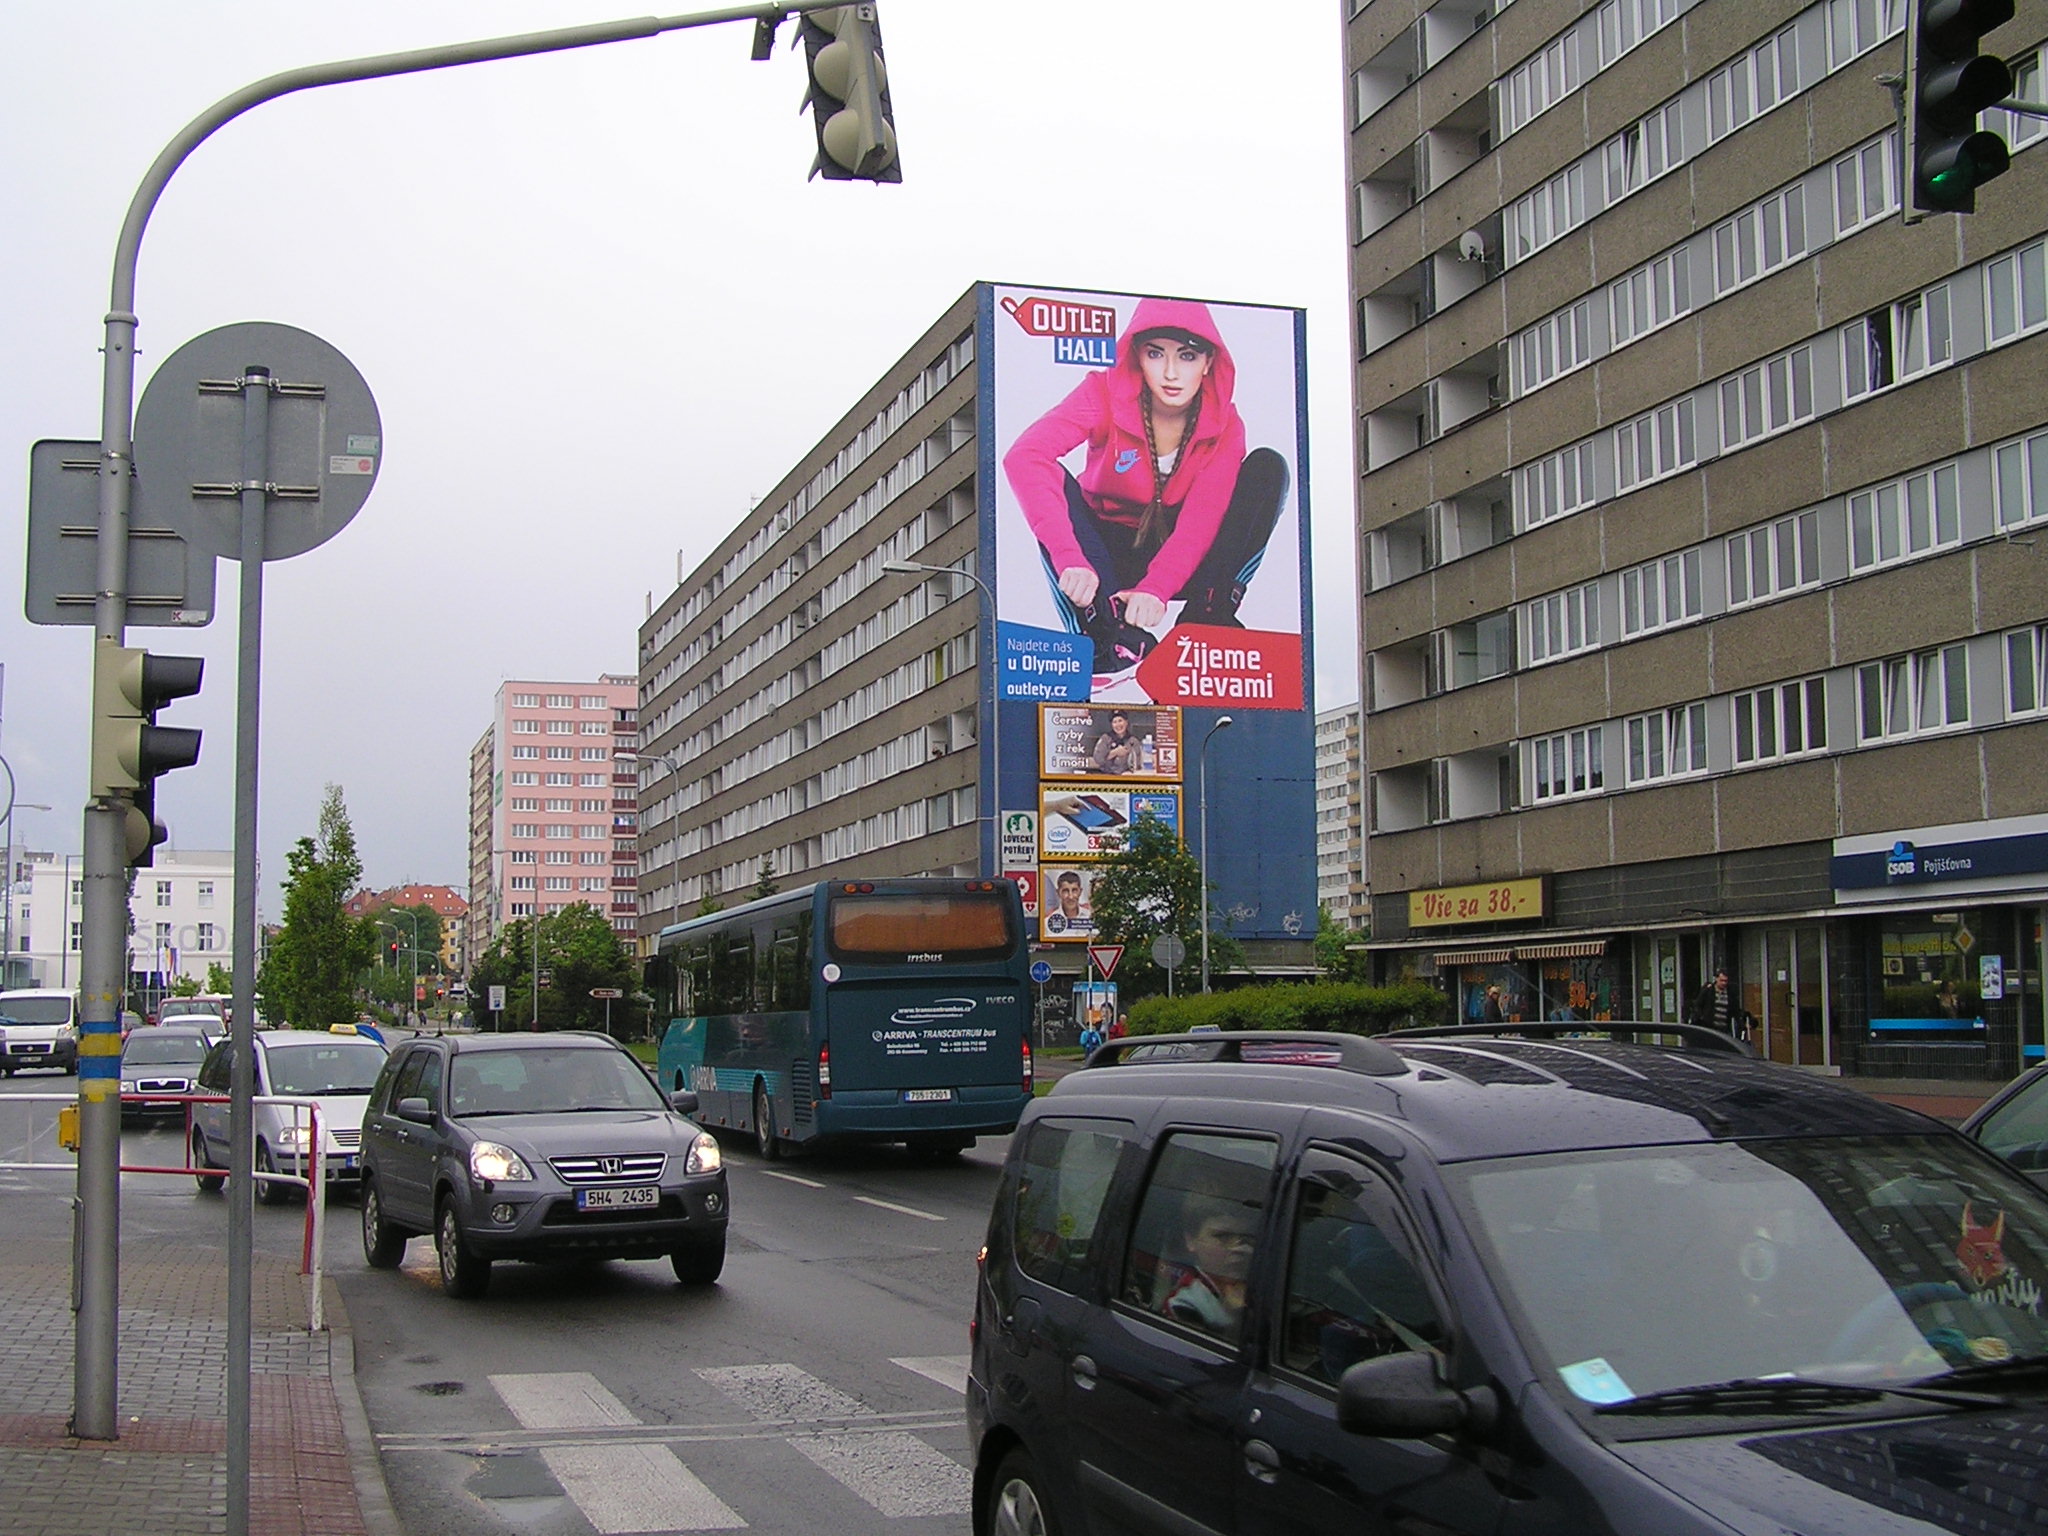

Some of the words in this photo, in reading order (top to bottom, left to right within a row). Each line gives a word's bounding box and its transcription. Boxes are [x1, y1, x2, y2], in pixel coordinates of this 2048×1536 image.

[1032, 303, 1113, 334] OUTLET
[1058, 337, 1114, 364] HALL
[1007, 638, 1049, 653] Najdete
[1053, 639, 1072, 653] nás
[1177, 635, 1261, 676] Žijeme
[1008, 659, 1017, 671] u
[1022, 655, 1080, 675] Olympie
[1007, 682, 1068, 698] outlety.cz
[1177, 670, 1273, 698] slevami
[1052, 711, 1093, 726] Čerstvé
[1057, 730, 1084, 742] ryby
[1056, 745, 1063, 754] z
[1066, 742, 1085, 754] řek
[1060, 757, 1089, 768] moří!
[1004, 834, 1034, 843] LOVECKÉ
[1924, 857, 1972, 876] Pojišťovna
[1457, 899, 1479, 920] za
[986, 996, 1015, 1004] IVECO
[884, 1031, 917, 1040] ARRIVA
[923, 1029, 982, 1039] TRANSCENTRUM
[983, 1029, 997, 1037] bus
[588, 1190, 612, 1205] 5H4
[622, 1189, 653, 1204] 2435
